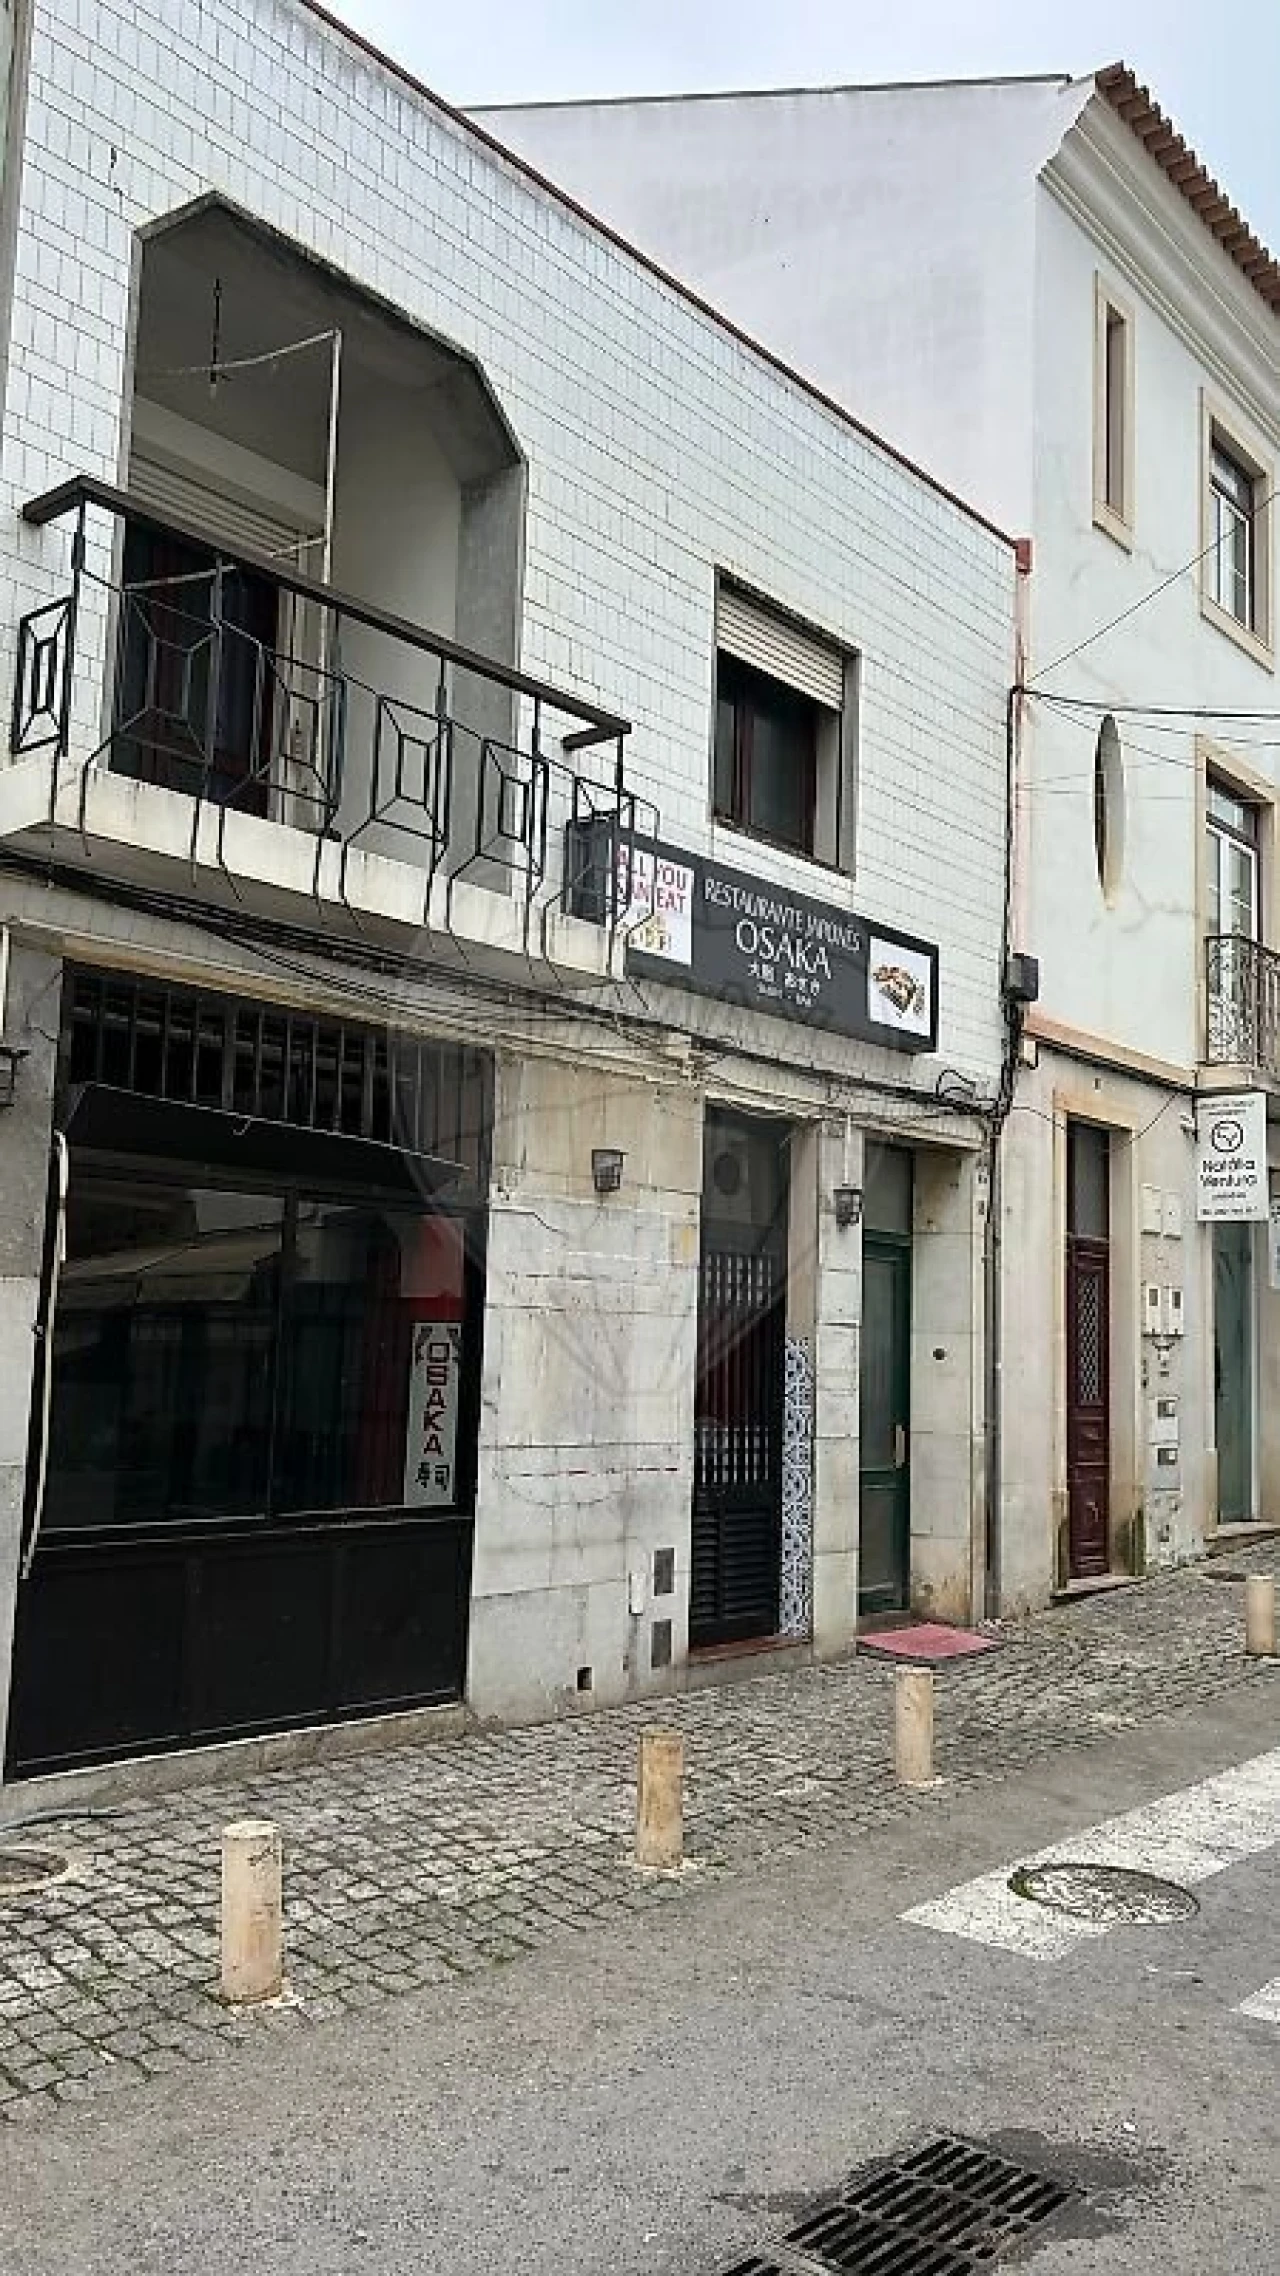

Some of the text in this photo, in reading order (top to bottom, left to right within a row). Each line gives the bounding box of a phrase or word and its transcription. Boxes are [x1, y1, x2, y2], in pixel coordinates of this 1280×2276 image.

[656, 888, 687, 913] EAT
[704, 877, 803, 933] RESTAURANTE
[735, 918, 832, 980] OSAKA
[424, 1342, 451, 1457] OSAKA
